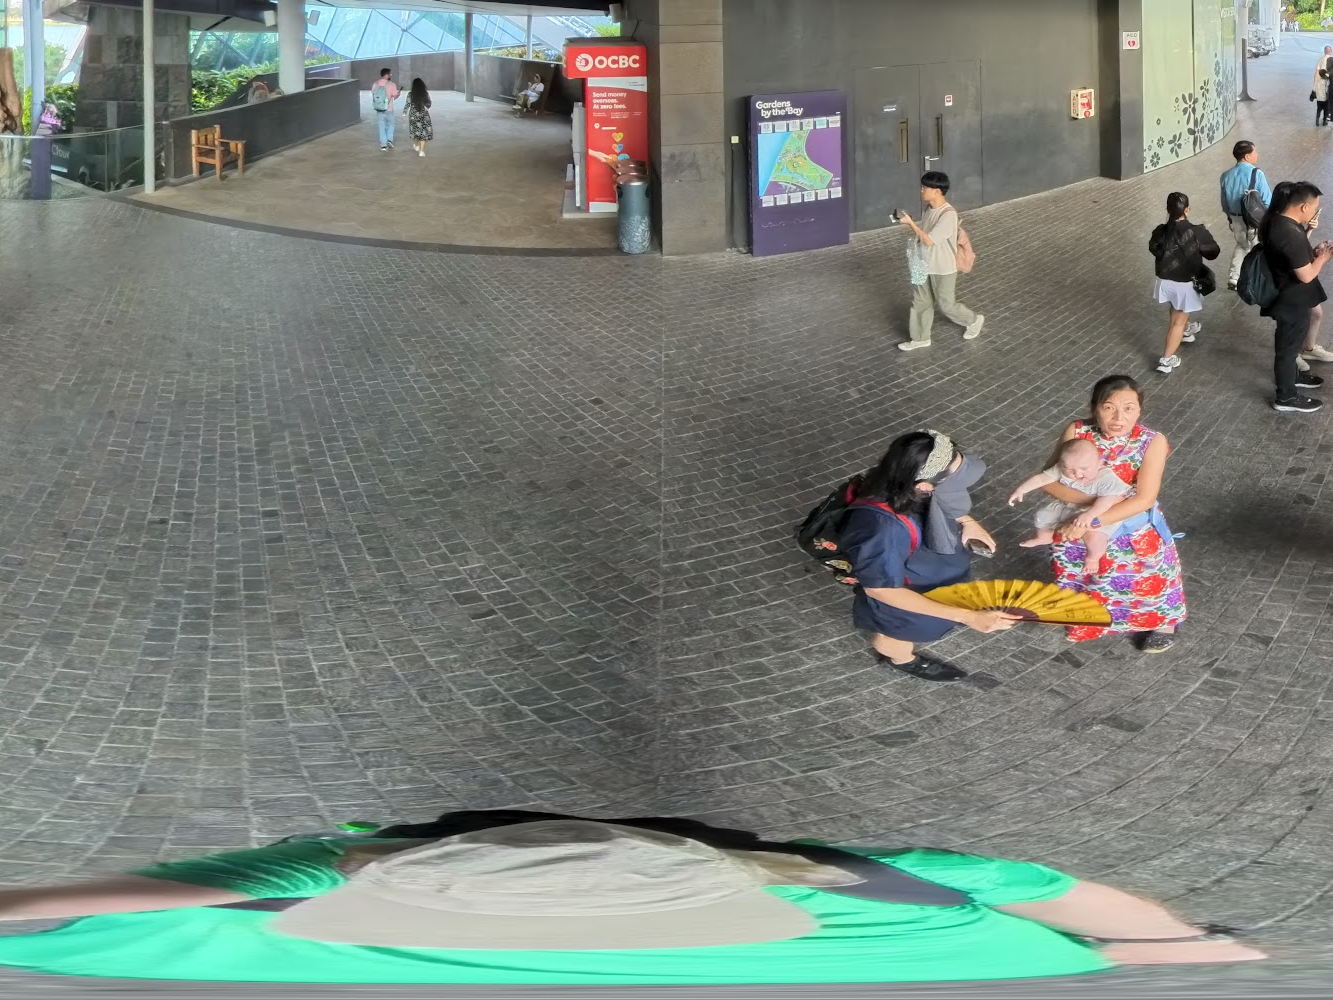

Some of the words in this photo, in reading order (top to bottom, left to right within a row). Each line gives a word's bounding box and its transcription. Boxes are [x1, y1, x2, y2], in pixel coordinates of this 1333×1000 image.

[594, 55, 640, 69] OCBC
[755, 100, 791, 109] Gardens
[760, 108, 772, 118] by
[772, 108, 785, 116] the
[785, 107, 803, 116] Bay
